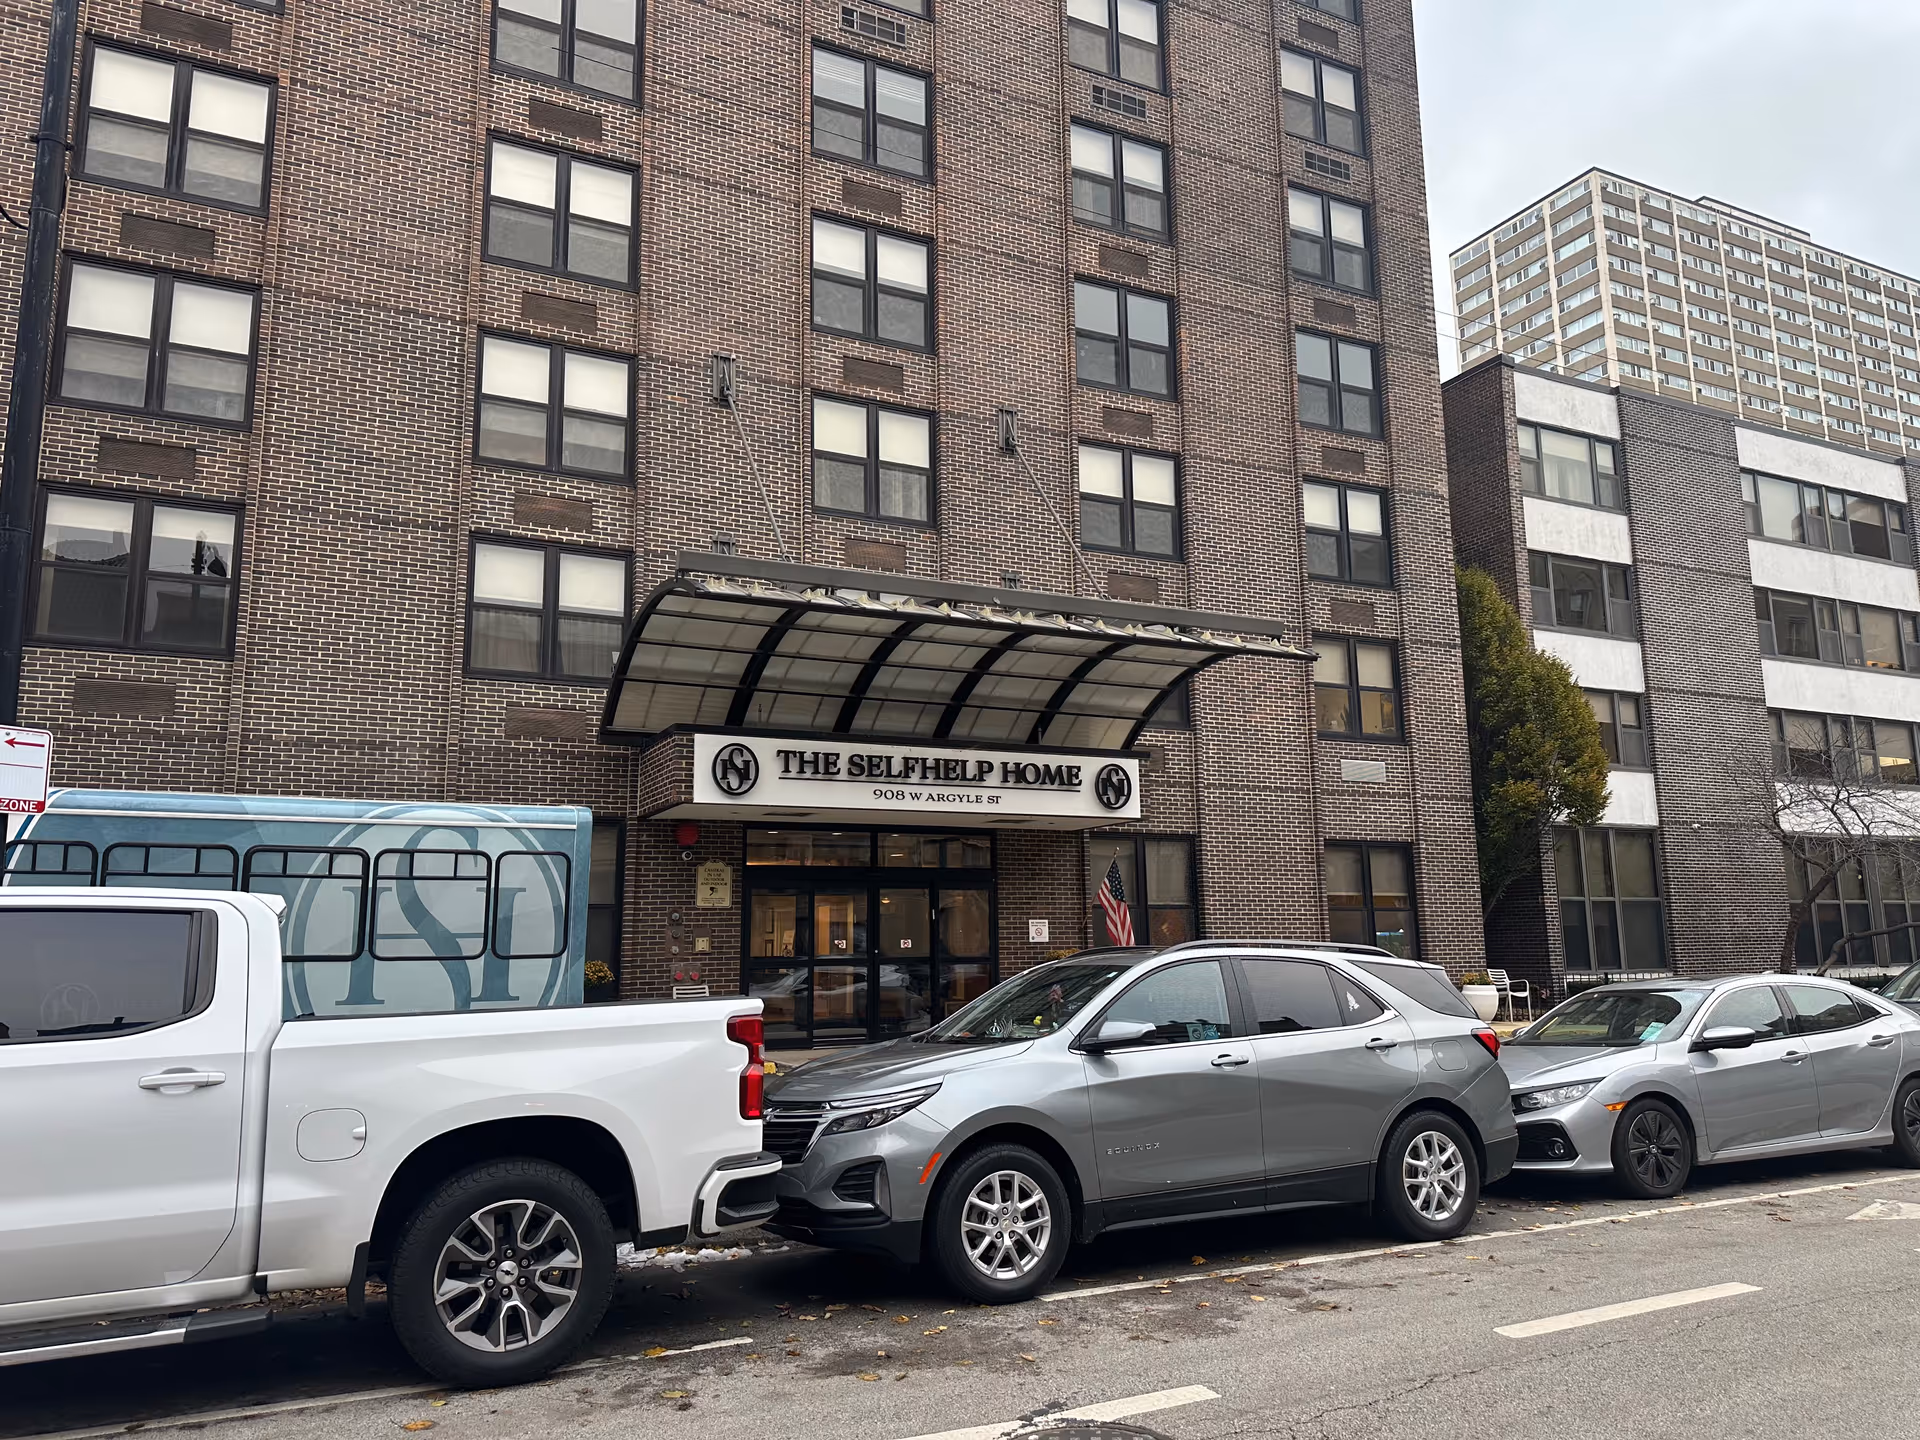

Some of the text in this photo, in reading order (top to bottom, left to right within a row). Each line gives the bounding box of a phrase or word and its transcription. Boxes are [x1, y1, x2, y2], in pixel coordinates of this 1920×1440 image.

[776, 749, 1083, 787] THE SELFHELP HOME
[873, 788, 1002, 804] 908 W ARGYLE ST
[0, 799, 38, 812] ZONE
[1105, 1142, 1160, 1155] EQUINOX
